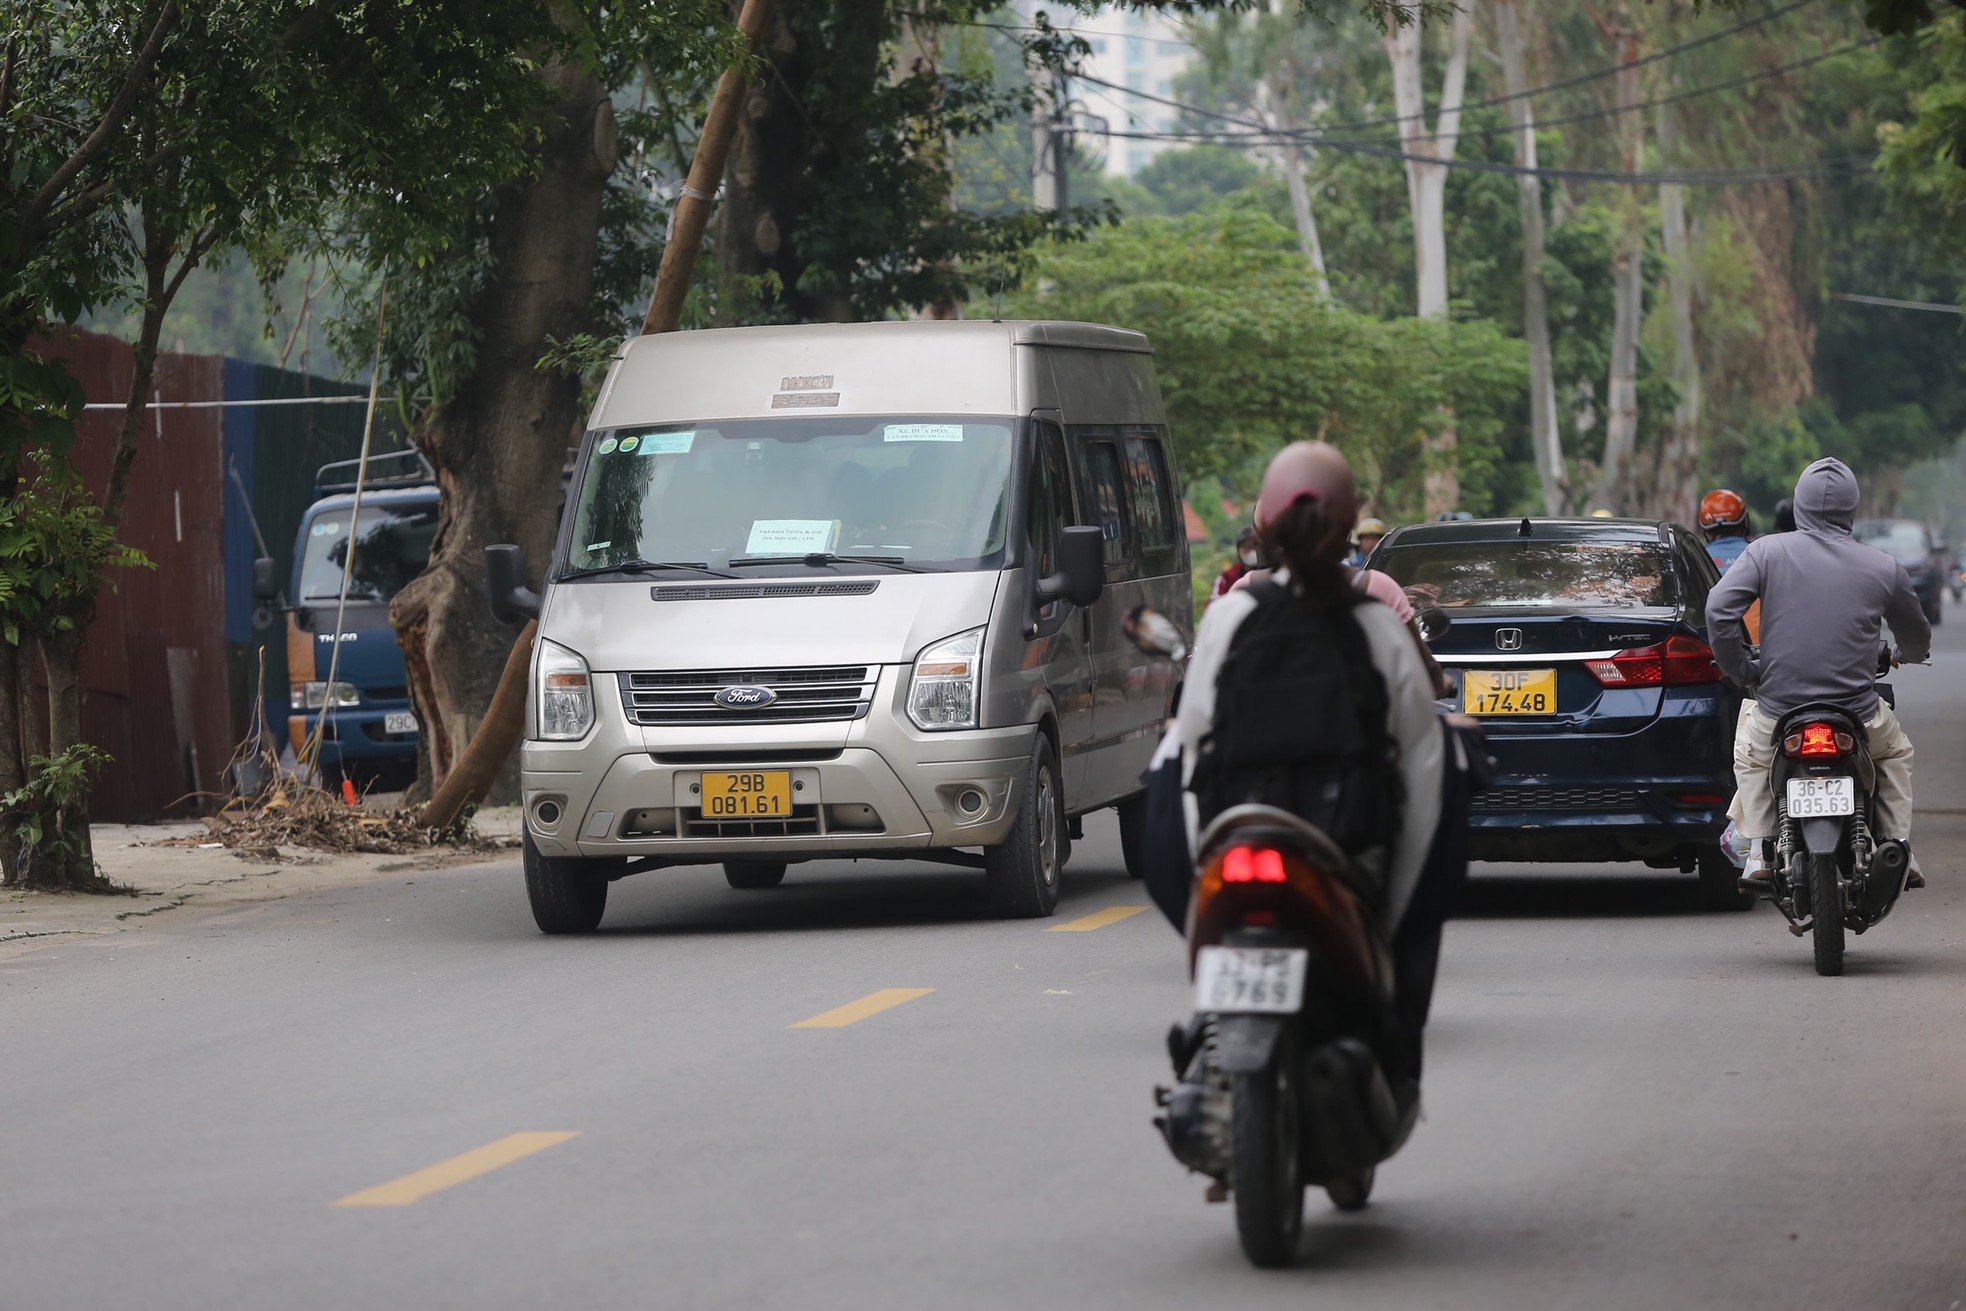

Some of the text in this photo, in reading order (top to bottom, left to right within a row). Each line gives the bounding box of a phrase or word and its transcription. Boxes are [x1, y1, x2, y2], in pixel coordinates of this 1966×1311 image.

[319, 633, 357, 642] THCO
[1490, 672, 1529, 691] 30F
[727, 689, 761, 703] Ford
[1477, 693, 1545, 712] 174.48
[727, 774, 765, 793] 29B
[1797, 780, 1843, 797] 36-C2
[712, 795, 779, 815] 081.61
[1793, 797, 1849, 814] 035.63
